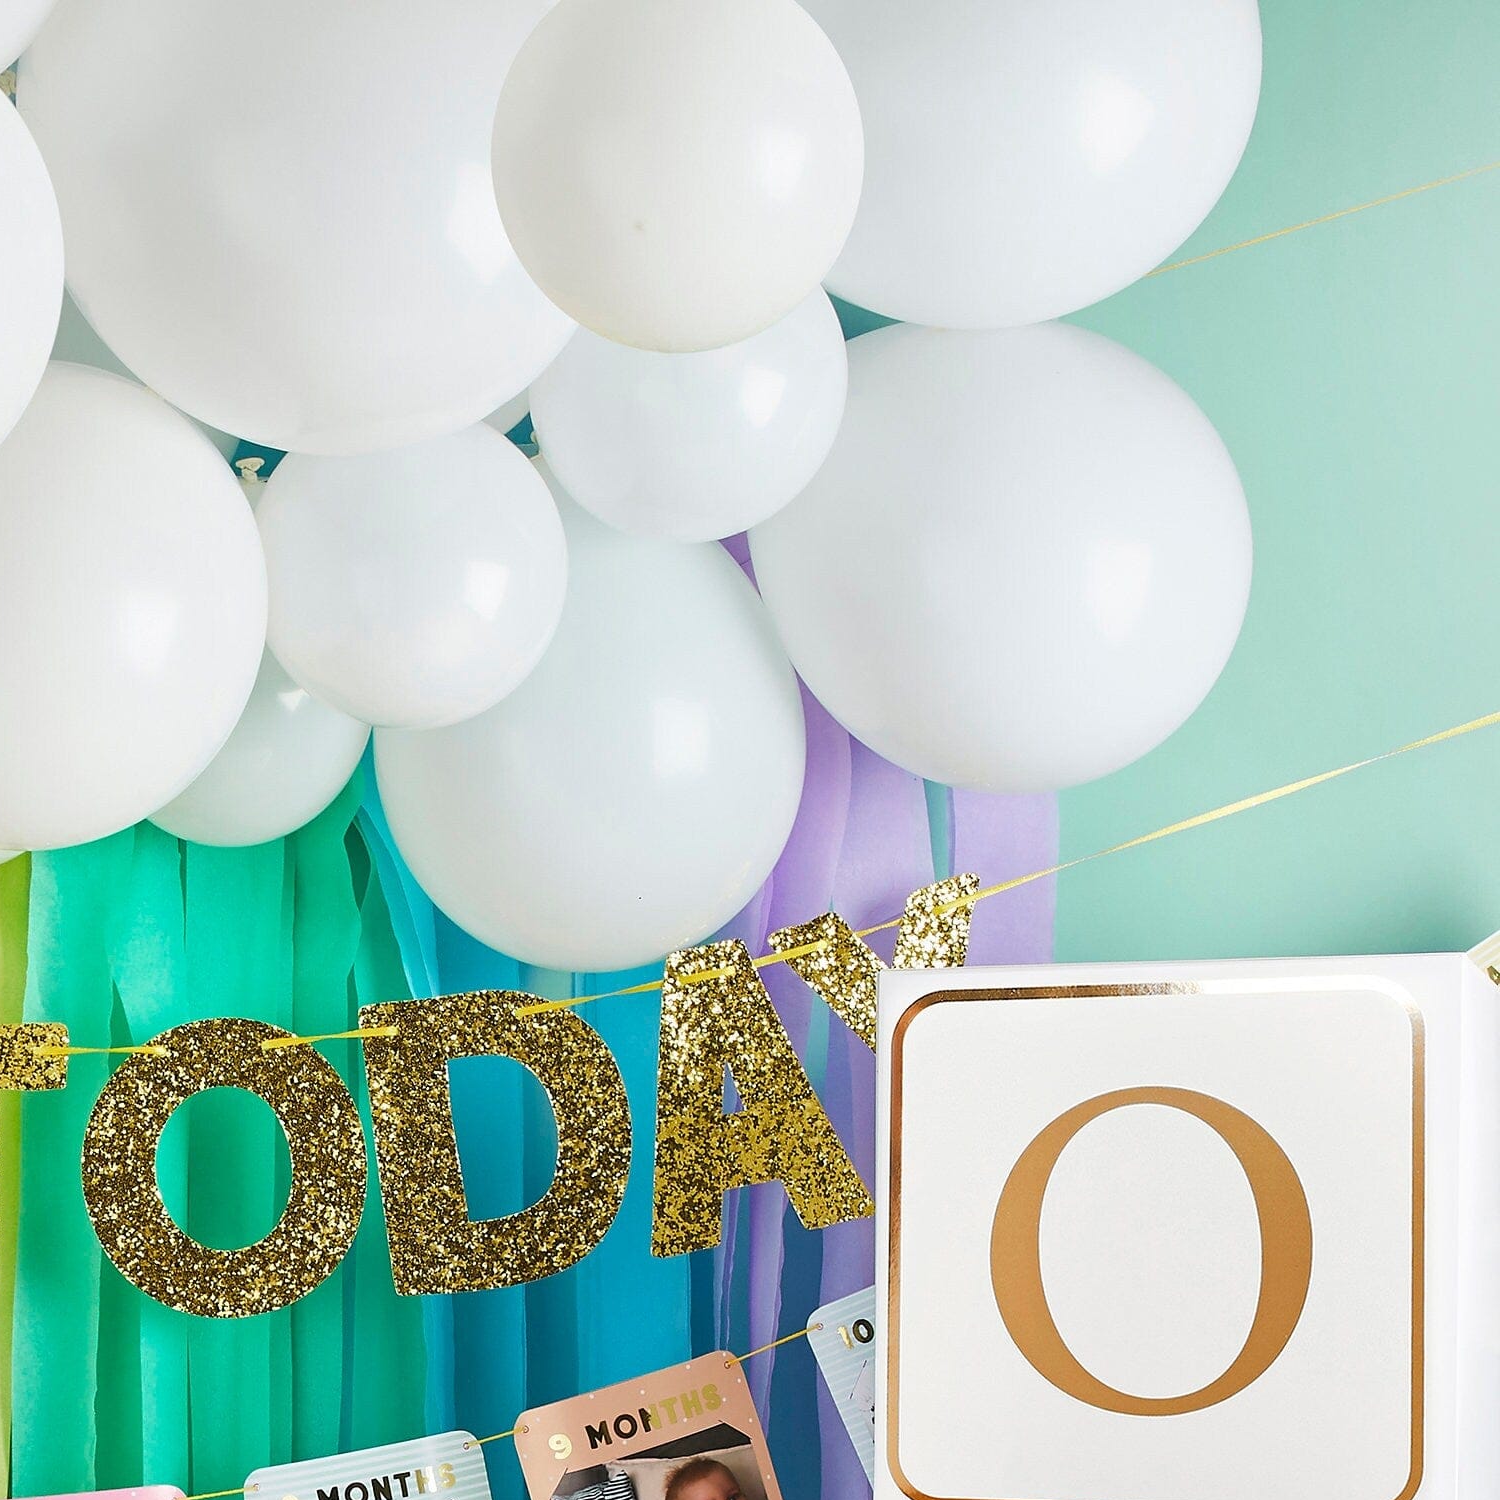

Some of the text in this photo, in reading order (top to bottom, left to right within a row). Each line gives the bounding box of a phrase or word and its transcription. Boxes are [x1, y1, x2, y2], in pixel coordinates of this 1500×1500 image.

[837, 1318, 875, 1350] 10
[548, 1383, 722, 1460] 9 MONTHS
